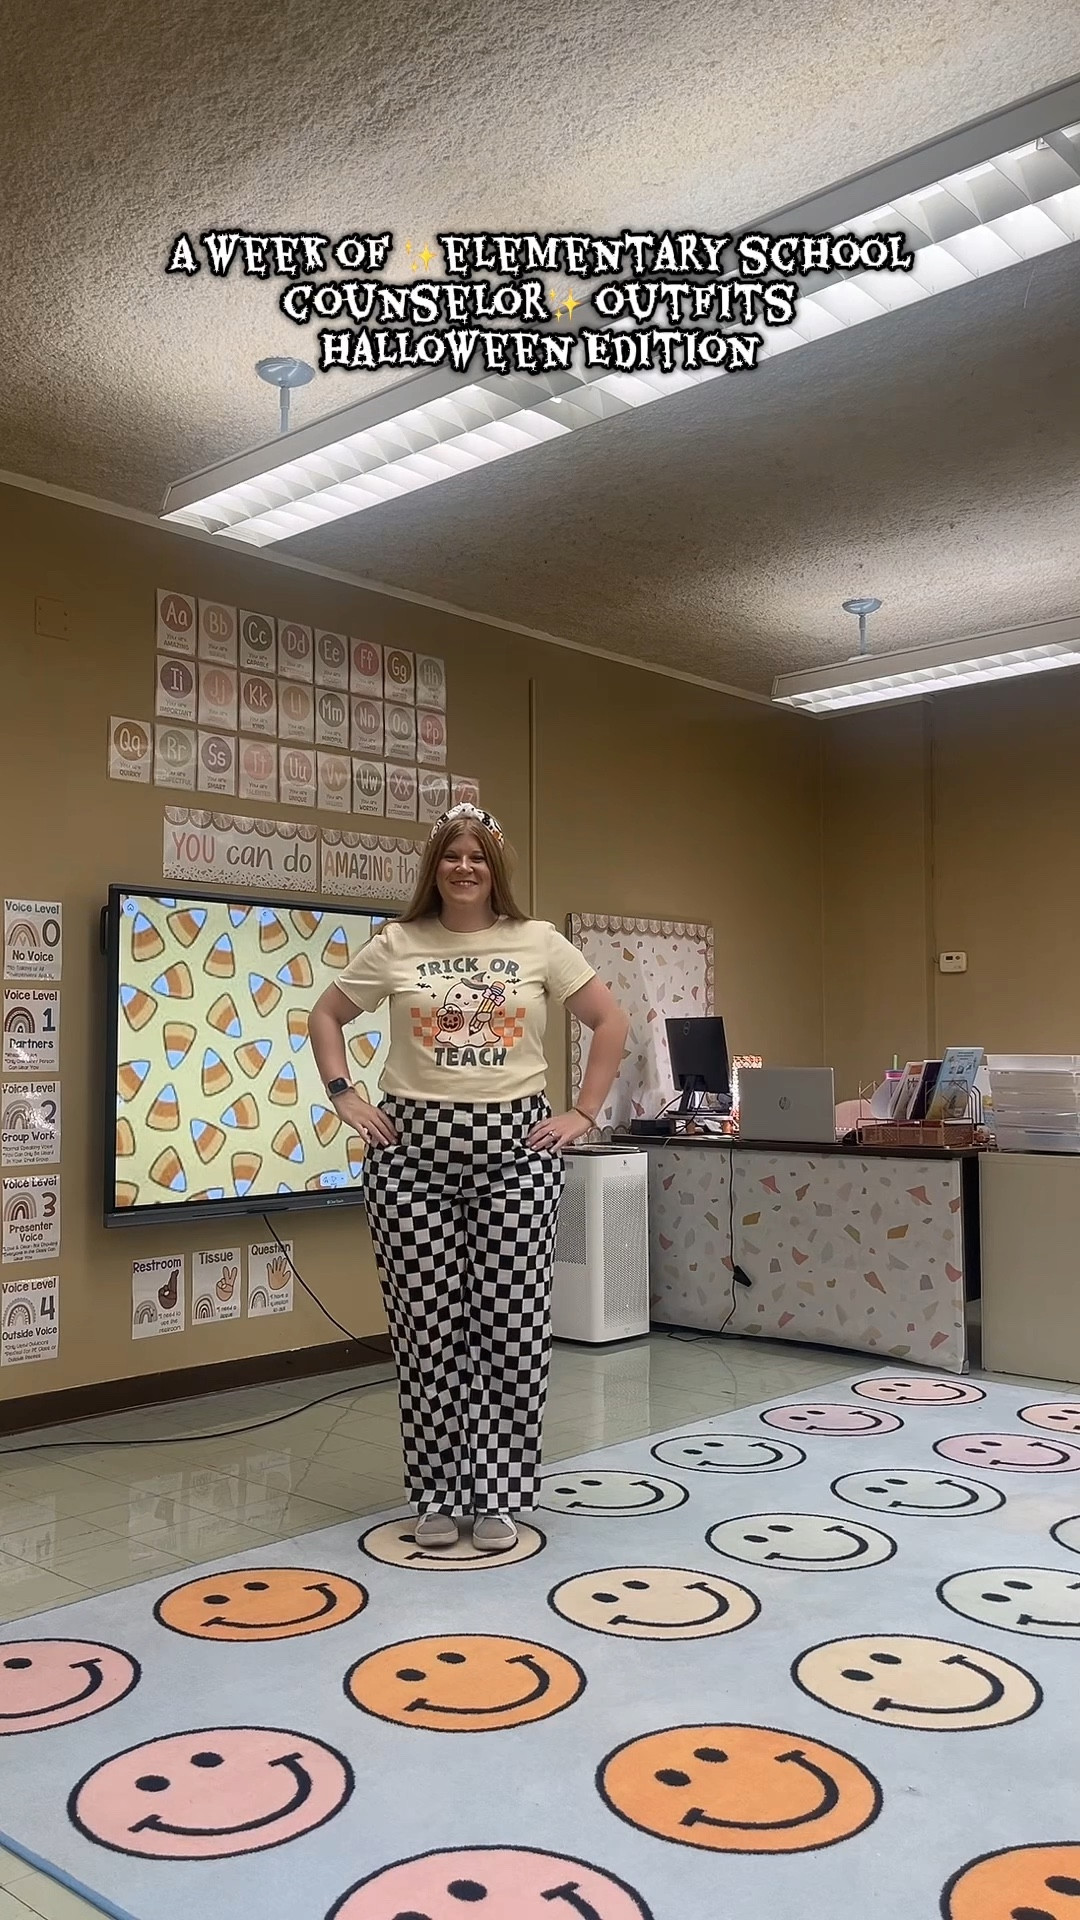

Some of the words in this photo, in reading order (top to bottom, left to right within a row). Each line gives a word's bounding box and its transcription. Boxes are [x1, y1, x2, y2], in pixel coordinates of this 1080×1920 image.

[166, 602, 188, 626] Aa
[209, 612, 228, 635] Bb
[248, 622, 268, 644] Cc
[287, 631, 305, 654] Dd
[324, 640, 340, 662] Ee
[360, 649, 373, 669] Ff
[170, 668, 183, 691] Ii
[392, 658, 406, 682] Gg
[424, 664, 438, 686] Hh
[210, 677, 226, 704] Jj
[249, 684, 268, 707] Kk
[290, 692, 301, 713] Ll
[322, 700, 342, 722] Mm
[360, 708, 375, 729] Nn
[392, 714, 408, 735] Oo
[120, 728, 142, 757] Qq
[426, 721, 439, 744] Pp
[168, 736, 186, 761] Rr
[208, 744, 226, 766] Ss
[254, 752, 266, 774] Tt
[289, 758, 307, 781] Uu
[326, 762, 341, 786] Vv
[360, 772, 378, 792] Ww
[394, 775, 410, 796] Xx
[426, 778, 440, 805] Yy
[172, 832, 216, 864] YOU
[226, 844, 273, 871] can
[283, 843, 312, 873] do
[324, 851, 393, 883] AMAZING
[396, 856, 418, 884] thi
[6, 900, 32, 912] Voice
[34, 904, 59, 914] Level
[42, 919, 60, 948] 0
[12, 950, 25, 960] No
[28, 950, 54, 962] Voice
[416, 957, 478, 976] TRICK
[490, 958, 520, 977] OR
[5, 990, 30, 1000] Voice
[33, 990, 58, 1000] Level
[43, 1008, 56, 1032] 1
[10, 1038, 54, 1048] Partners
[434, 1048, 506, 1066] TEACH
[2, 1084, 28, 1094] Voice
[31, 1083, 56, 1093] Level
[40, 1100, 56, 1124] 2
[2, 1132, 30, 1144] Group
[32, 1131, 54, 1140] Work
[3, 1180, 29, 1190] Voice
[32, 1176, 57, 1187] Level
[42, 1192, 56, 1217] 3
[10, 1222, 54, 1234] Presenter
[20, 1233, 44, 1242] Voice
[199, 1252, 234, 1265] Tissue
[251, 1244, 291, 1256] Questin
[133, 1259, 182, 1274] Restroom
[2, 1282, 28, 1294] Voice
[32, 1278, 56, 1290] Level
[40, 1296, 56, 1320] 4
[2, 1330, 34, 1340] Outside
[36, 1327, 58, 1336] Voice
